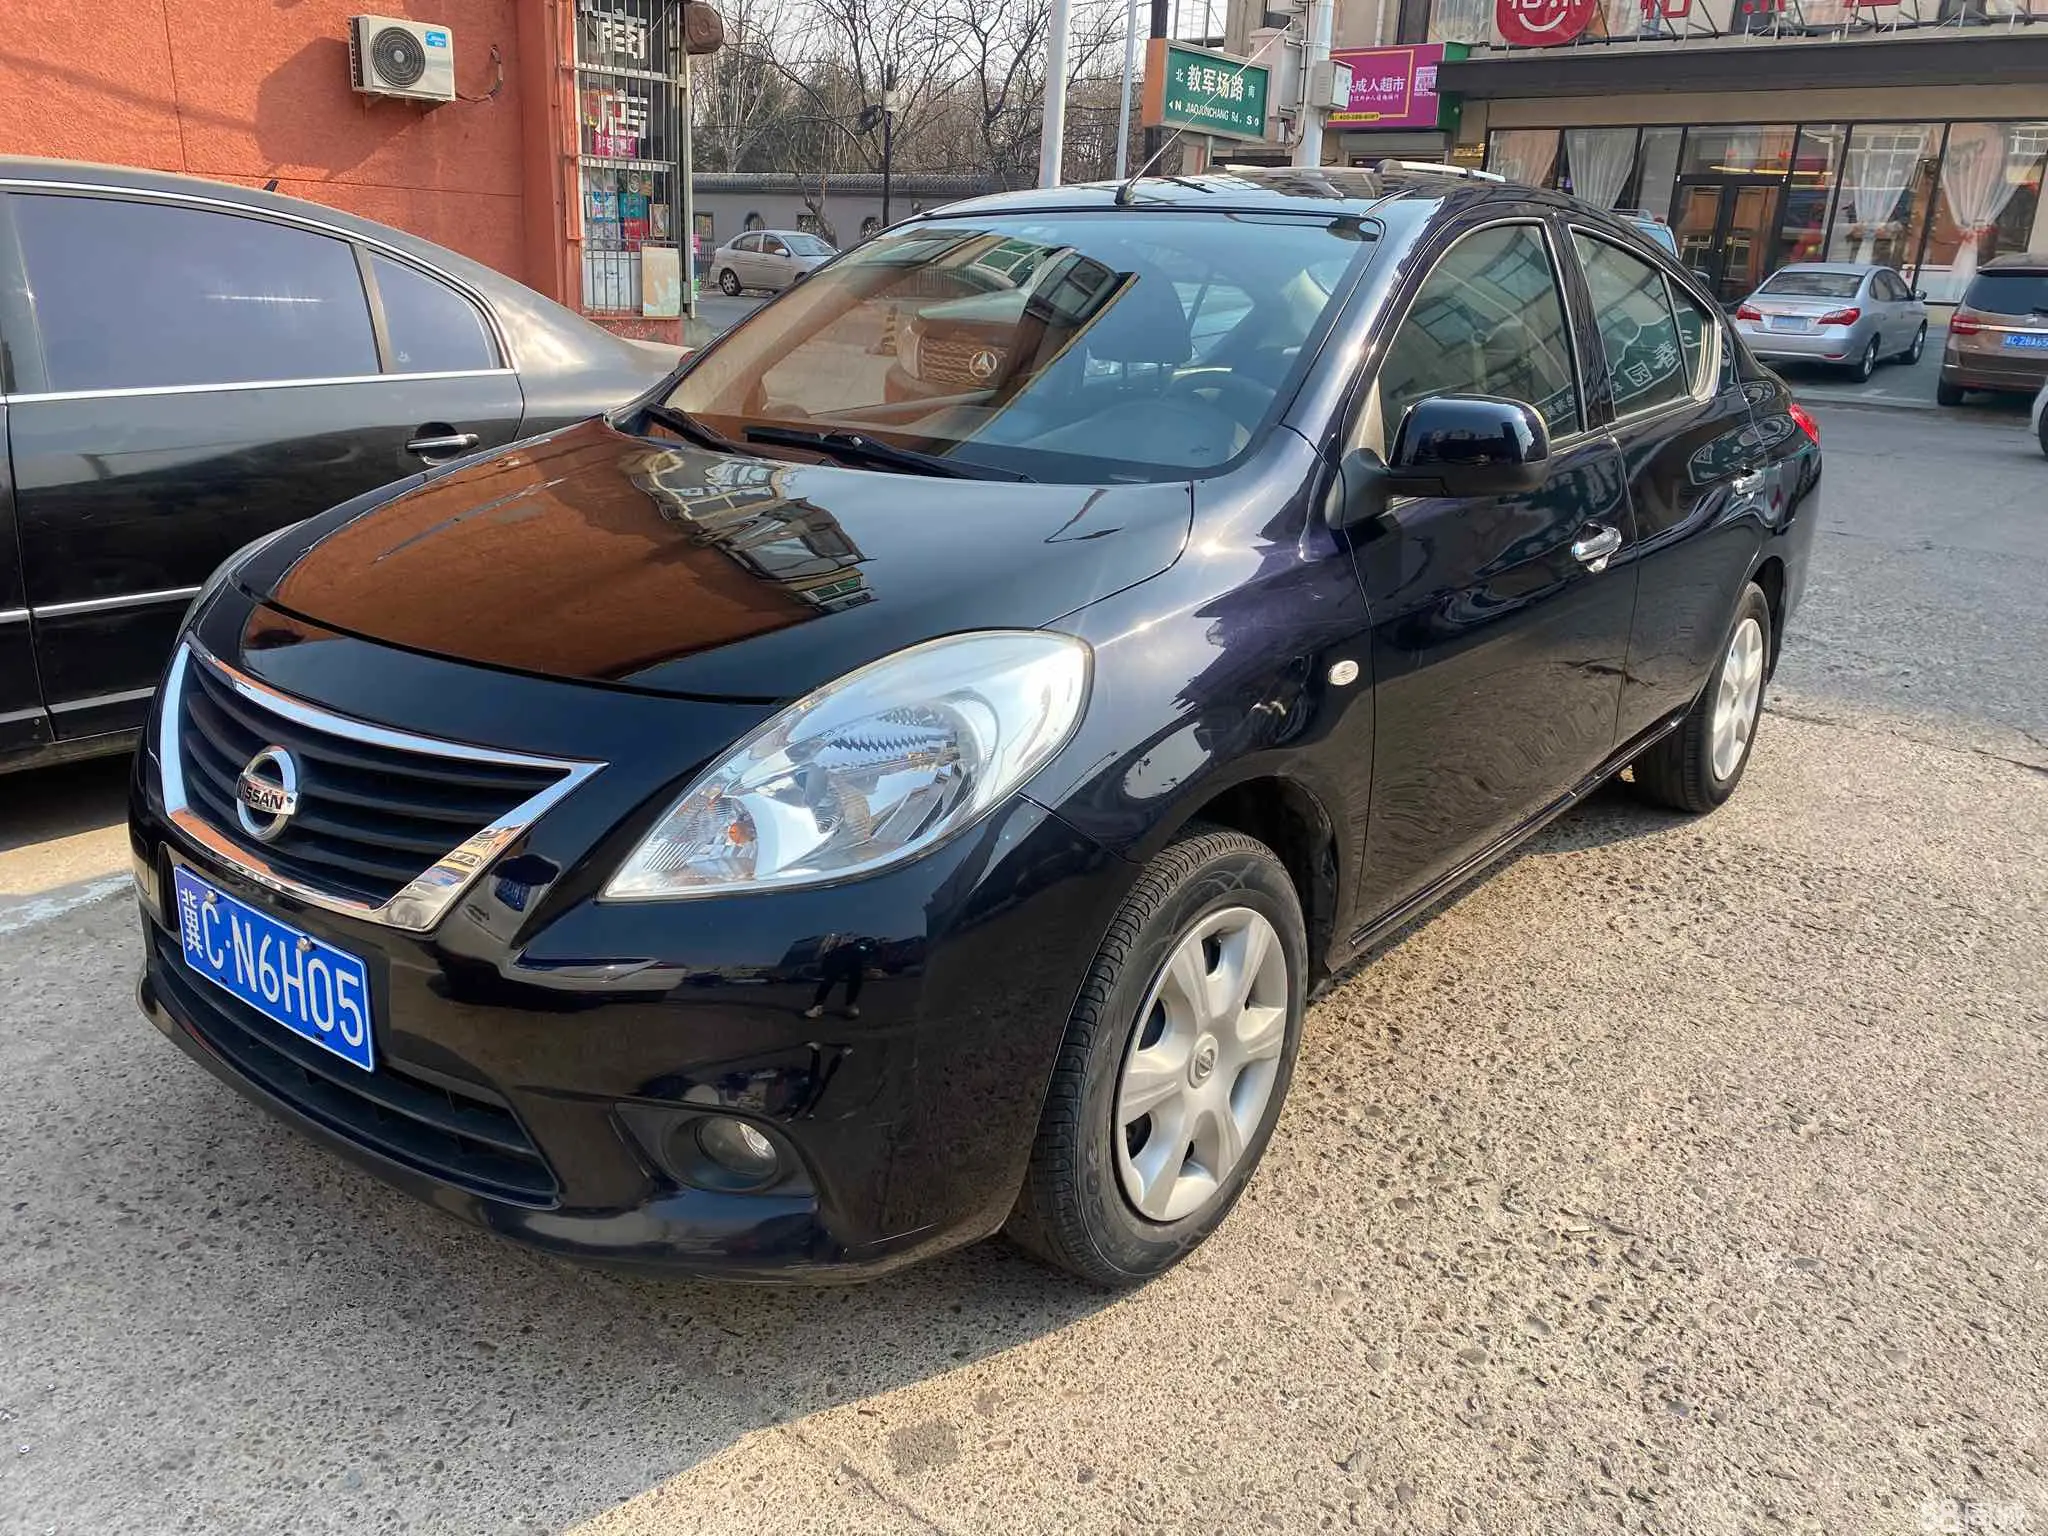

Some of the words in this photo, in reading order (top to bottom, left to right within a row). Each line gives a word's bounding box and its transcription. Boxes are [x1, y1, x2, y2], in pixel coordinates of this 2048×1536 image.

[592, 8, 648, 139] 商店
[1175, 68, 1184, 82] 北
[1187, 63, 1244, 102] 教军场路
[1175, 99, 1182, 111] N
[1246, 115, 1253, 126] S
